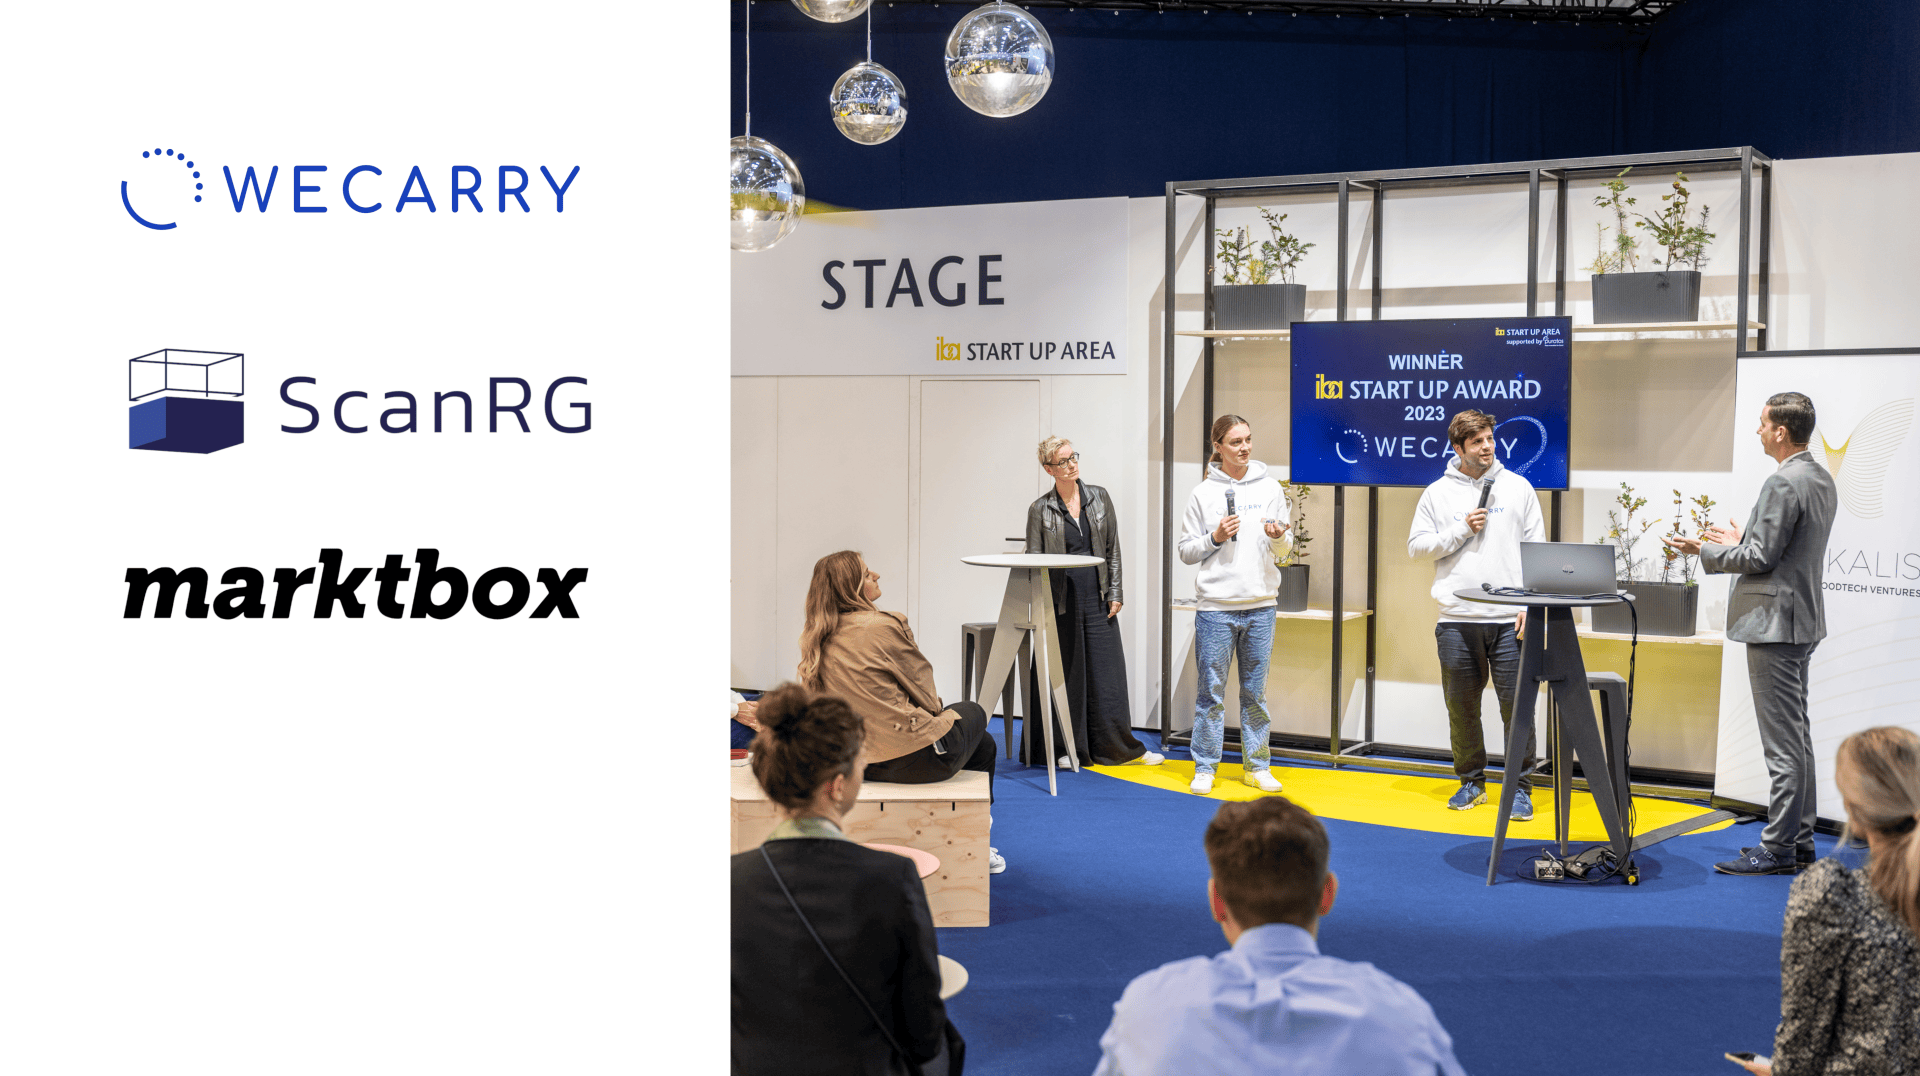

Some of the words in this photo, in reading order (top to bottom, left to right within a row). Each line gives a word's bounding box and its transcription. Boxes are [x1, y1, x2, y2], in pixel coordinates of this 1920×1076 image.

[821, 254, 1005, 310] STAGE
[1506, 328, 1529, 336] START
[1530, 328, 1540, 336] UP
[1541, 328, 1561, 336] AREA
[1506, 338, 1535, 346] supported
[1535, 338, 1543, 346] by
[936, 336, 961, 361] iba
[967, 342, 1024, 361] START
[1030, 342, 1056, 360] UP
[1061, 341, 1116, 360] AREA
[1388, 354, 1463, 370] WINNER
[1315, 373, 1343, 399] iba
[1350, 380, 1413, 400] START
[1418, 380, 1449, 399] UP
[1453, 379, 1542, 399] AWARD
[1404, 405, 1445, 421] 2023
[1374, 436, 1518, 459] WECAY
[1828, 548, 1920, 580] KALIS
[1821, 581, 1868, 593] OODTECH
[1870, 585, 1920, 598] VENTURES
